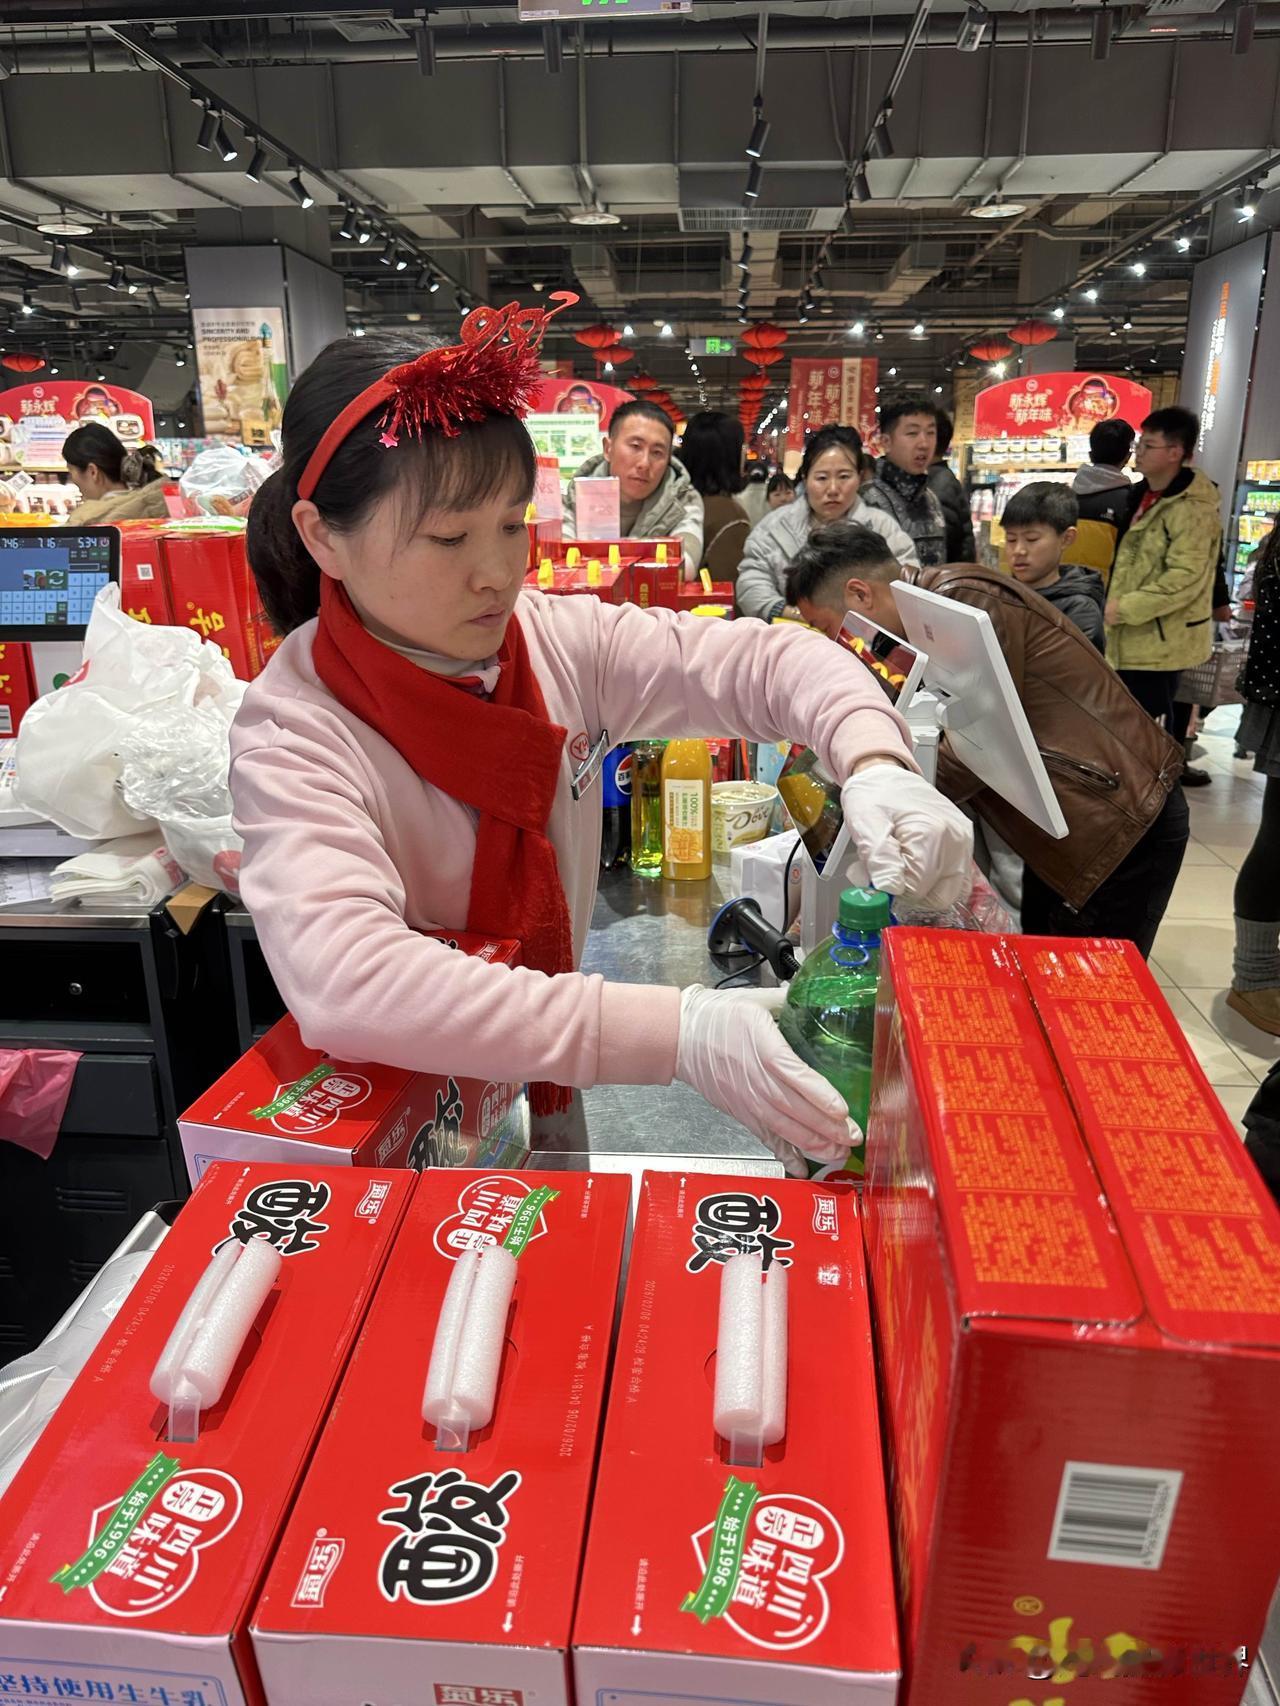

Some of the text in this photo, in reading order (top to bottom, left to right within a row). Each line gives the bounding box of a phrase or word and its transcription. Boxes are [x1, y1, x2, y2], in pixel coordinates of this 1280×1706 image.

[20, 398, 57, 414] 新永辉
[807, 370, 824, 424] 新年味
[1009, 392, 1048, 411] 新永辉
[1014, 408, 1052, 425] 新年味
[689, 793, 698, 816] 100%
[725, 809, 769, 830] Dove
[274, 1077, 314, 1108] 始于1996
[323, 1079, 360, 1097] 正宗
[460, 1189, 501, 1227] 四川
[485, 1194, 524, 1232] 味道
[509, 1204, 536, 1246] 始于1996
[817, 1196, 837, 1232] 菊乐
[560, 1409, 579, 1457] 2026/02/06
[94, 1490, 149, 1560] 始于1996
[132, 1482, 221, 1591] 正宗 四川
[105, 1511, 173, 1580] 味道
[712, 1515, 743, 1588] 始于1996
[298, 1543, 339, 1603] 菊乐
[731, 1538, 778, 1609] 味道
[760, 1508, 821, 1622] 正宗 四川
[0, 1674, 206, 1706] 坚持使用生牛乳
